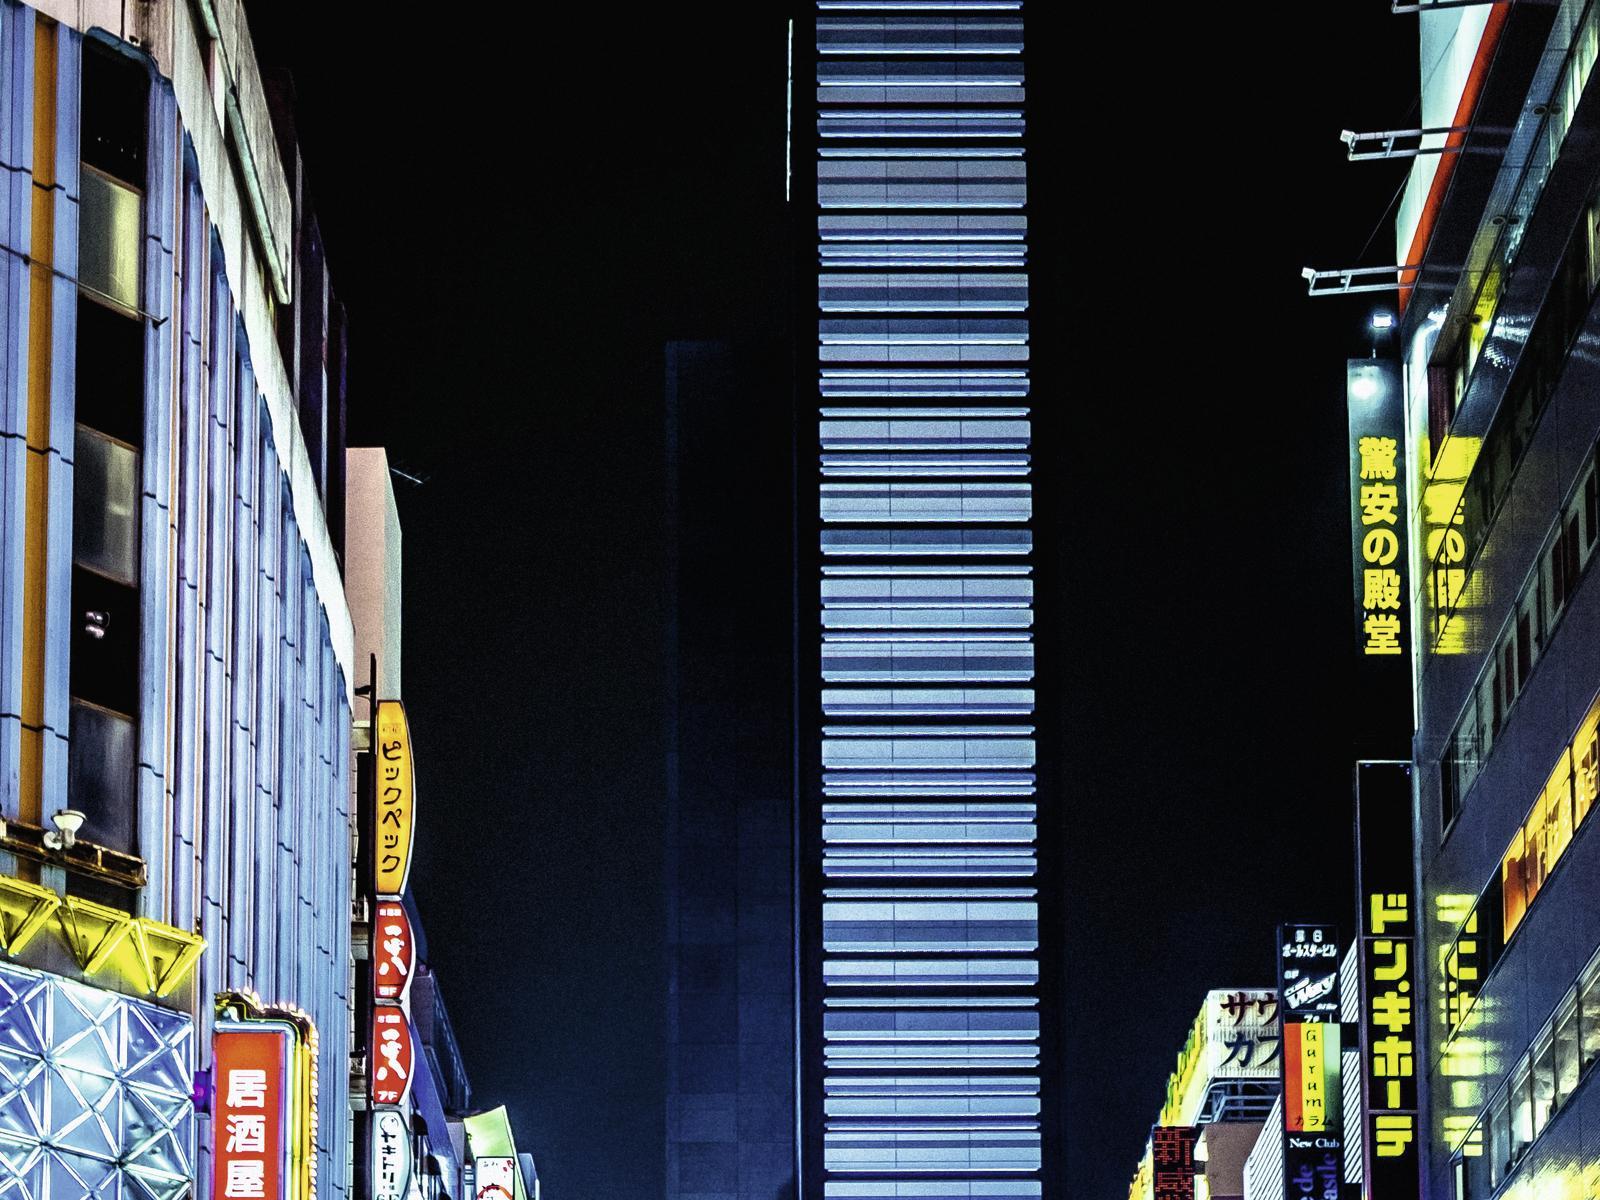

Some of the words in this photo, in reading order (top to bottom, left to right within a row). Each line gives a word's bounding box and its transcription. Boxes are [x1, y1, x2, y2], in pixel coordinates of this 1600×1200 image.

[225, 1069, 269, 1200] 居酒屋
[1288, 1137, 1313, 1149] New
[1315, 1137, 1340, 1149] Club
